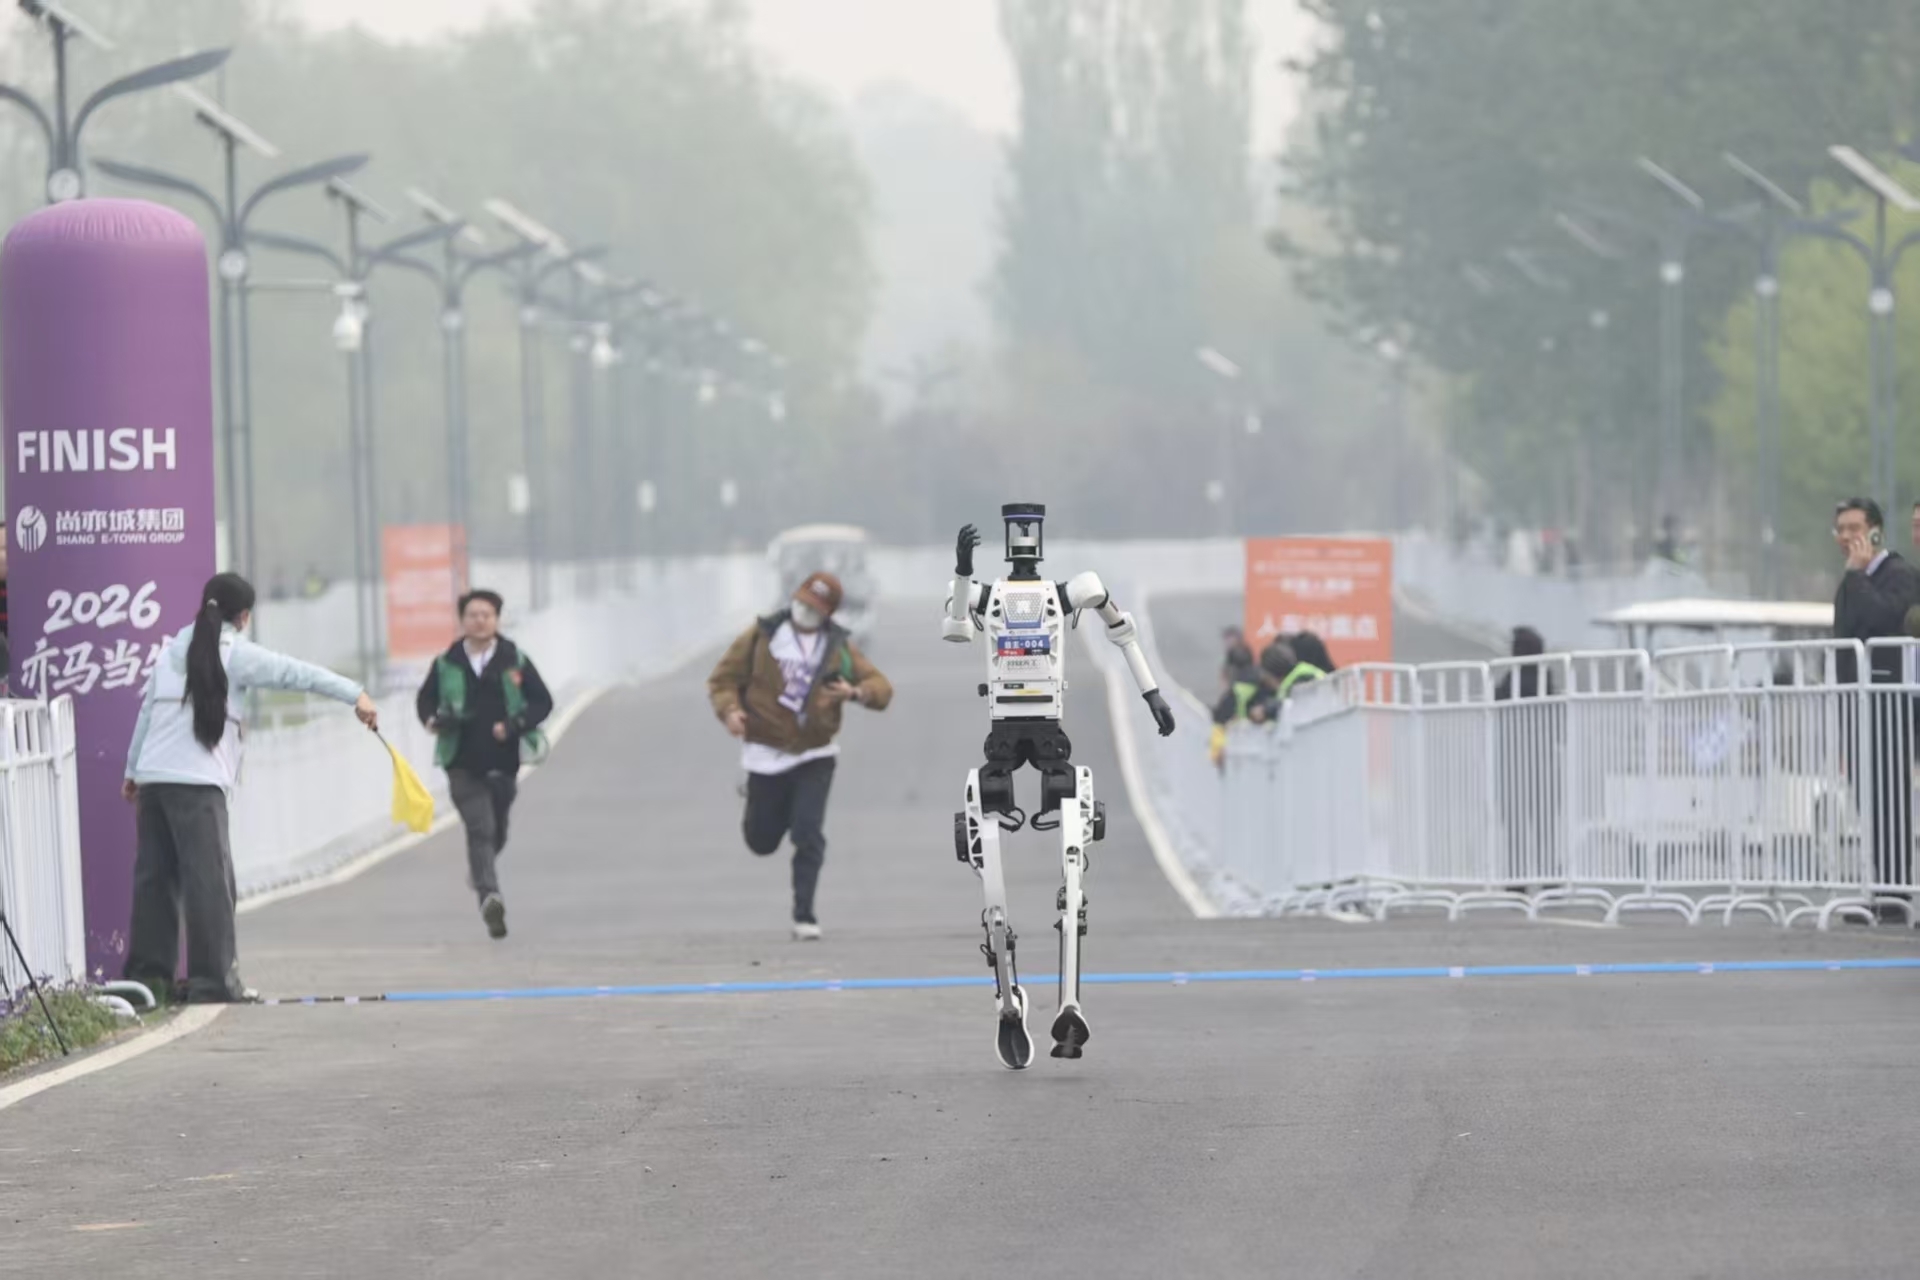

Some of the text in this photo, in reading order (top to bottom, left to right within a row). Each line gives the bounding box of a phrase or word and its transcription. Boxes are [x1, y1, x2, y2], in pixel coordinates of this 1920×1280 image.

[17, 427, 176, 473] FINISH
[56, 507, 184, 533] 尚亦城集团
[56, 532, 185, 545] SHANG E-TOWN GROUP
[43, 580, 161, 634] 2026
